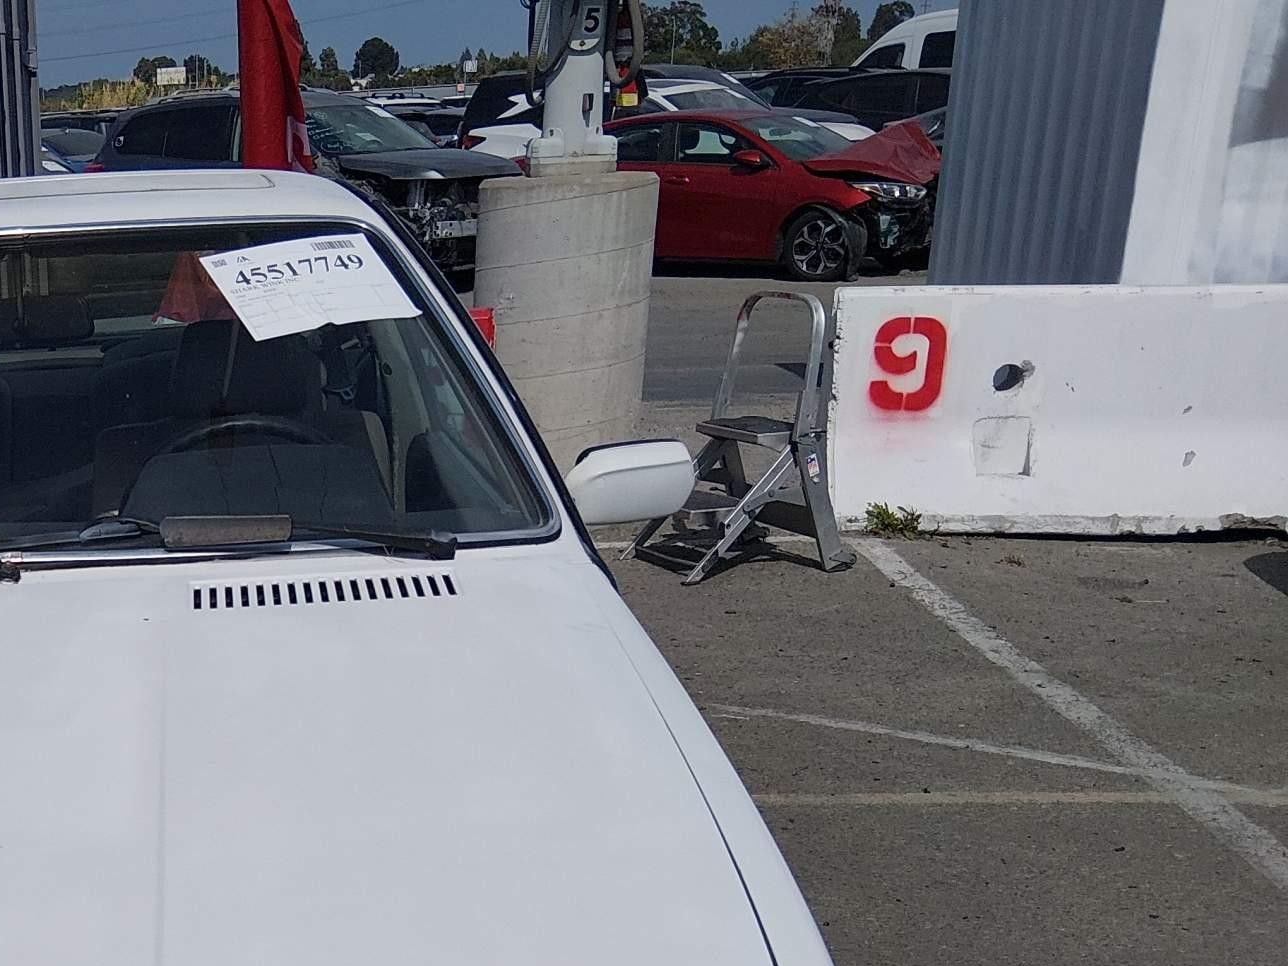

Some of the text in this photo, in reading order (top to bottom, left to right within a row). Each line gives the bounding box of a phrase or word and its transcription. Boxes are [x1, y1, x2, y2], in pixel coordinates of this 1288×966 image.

[584, 8, 601, 33] 5
[235, 254, 364, 285] 45517749
[868, 316, 948, 411] 9
